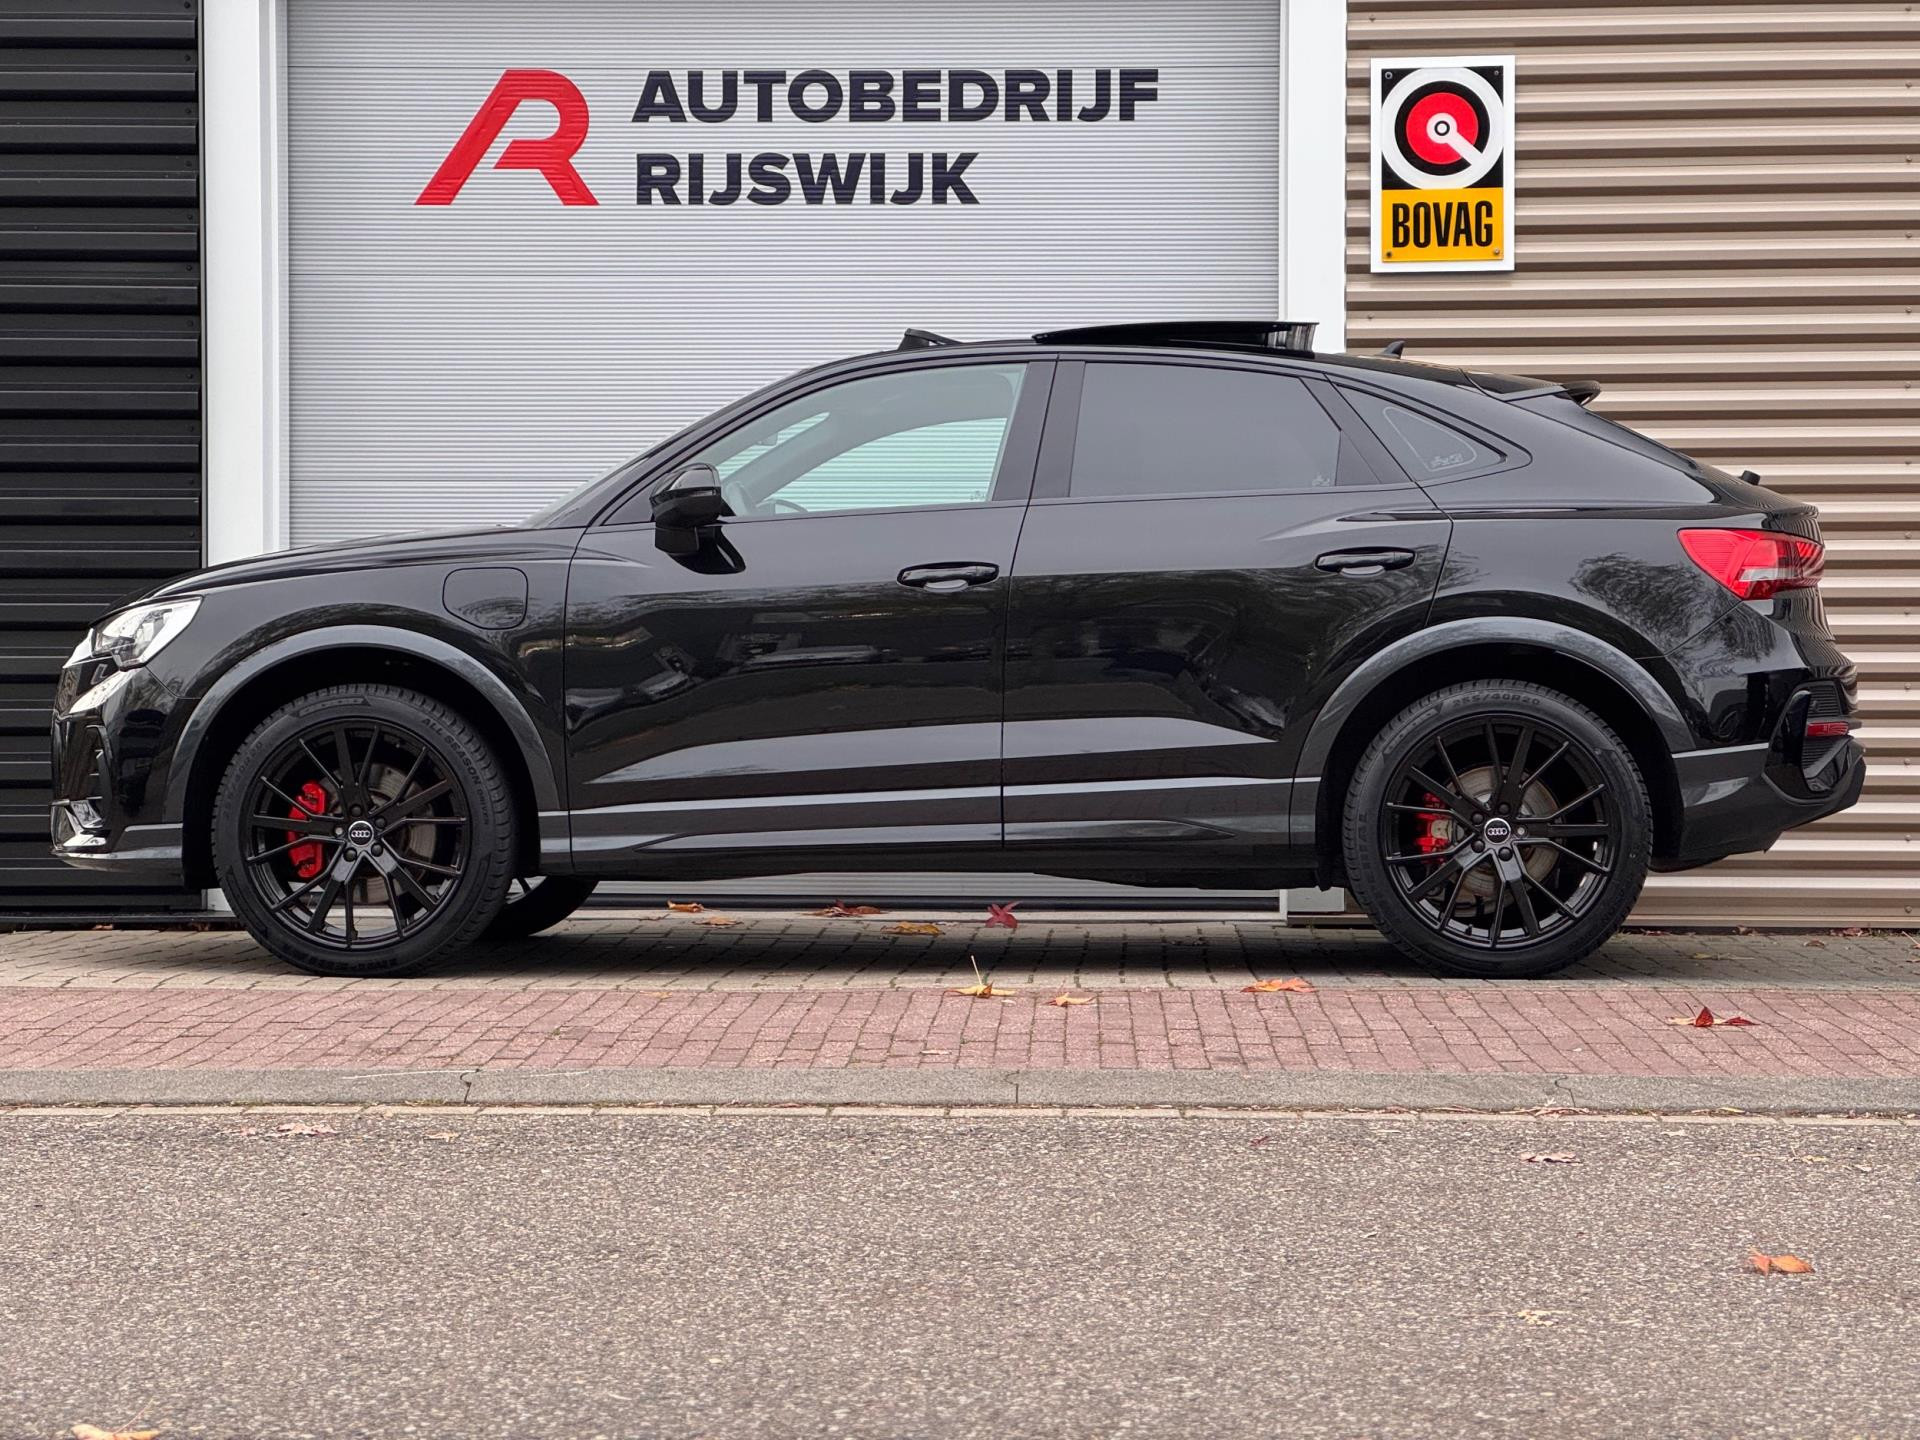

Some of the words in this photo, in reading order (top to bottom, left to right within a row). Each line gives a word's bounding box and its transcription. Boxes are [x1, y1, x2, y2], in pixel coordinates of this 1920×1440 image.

[631, 68, 1159, 123] AUTOBEDRIJF
[636, 152, 980, 205] RIJSWIJK
[1392, 201, 1494, 248] BOVAG
[421, 718, 443, 736] ALL
[444, 735, 482, 785] SEASON
